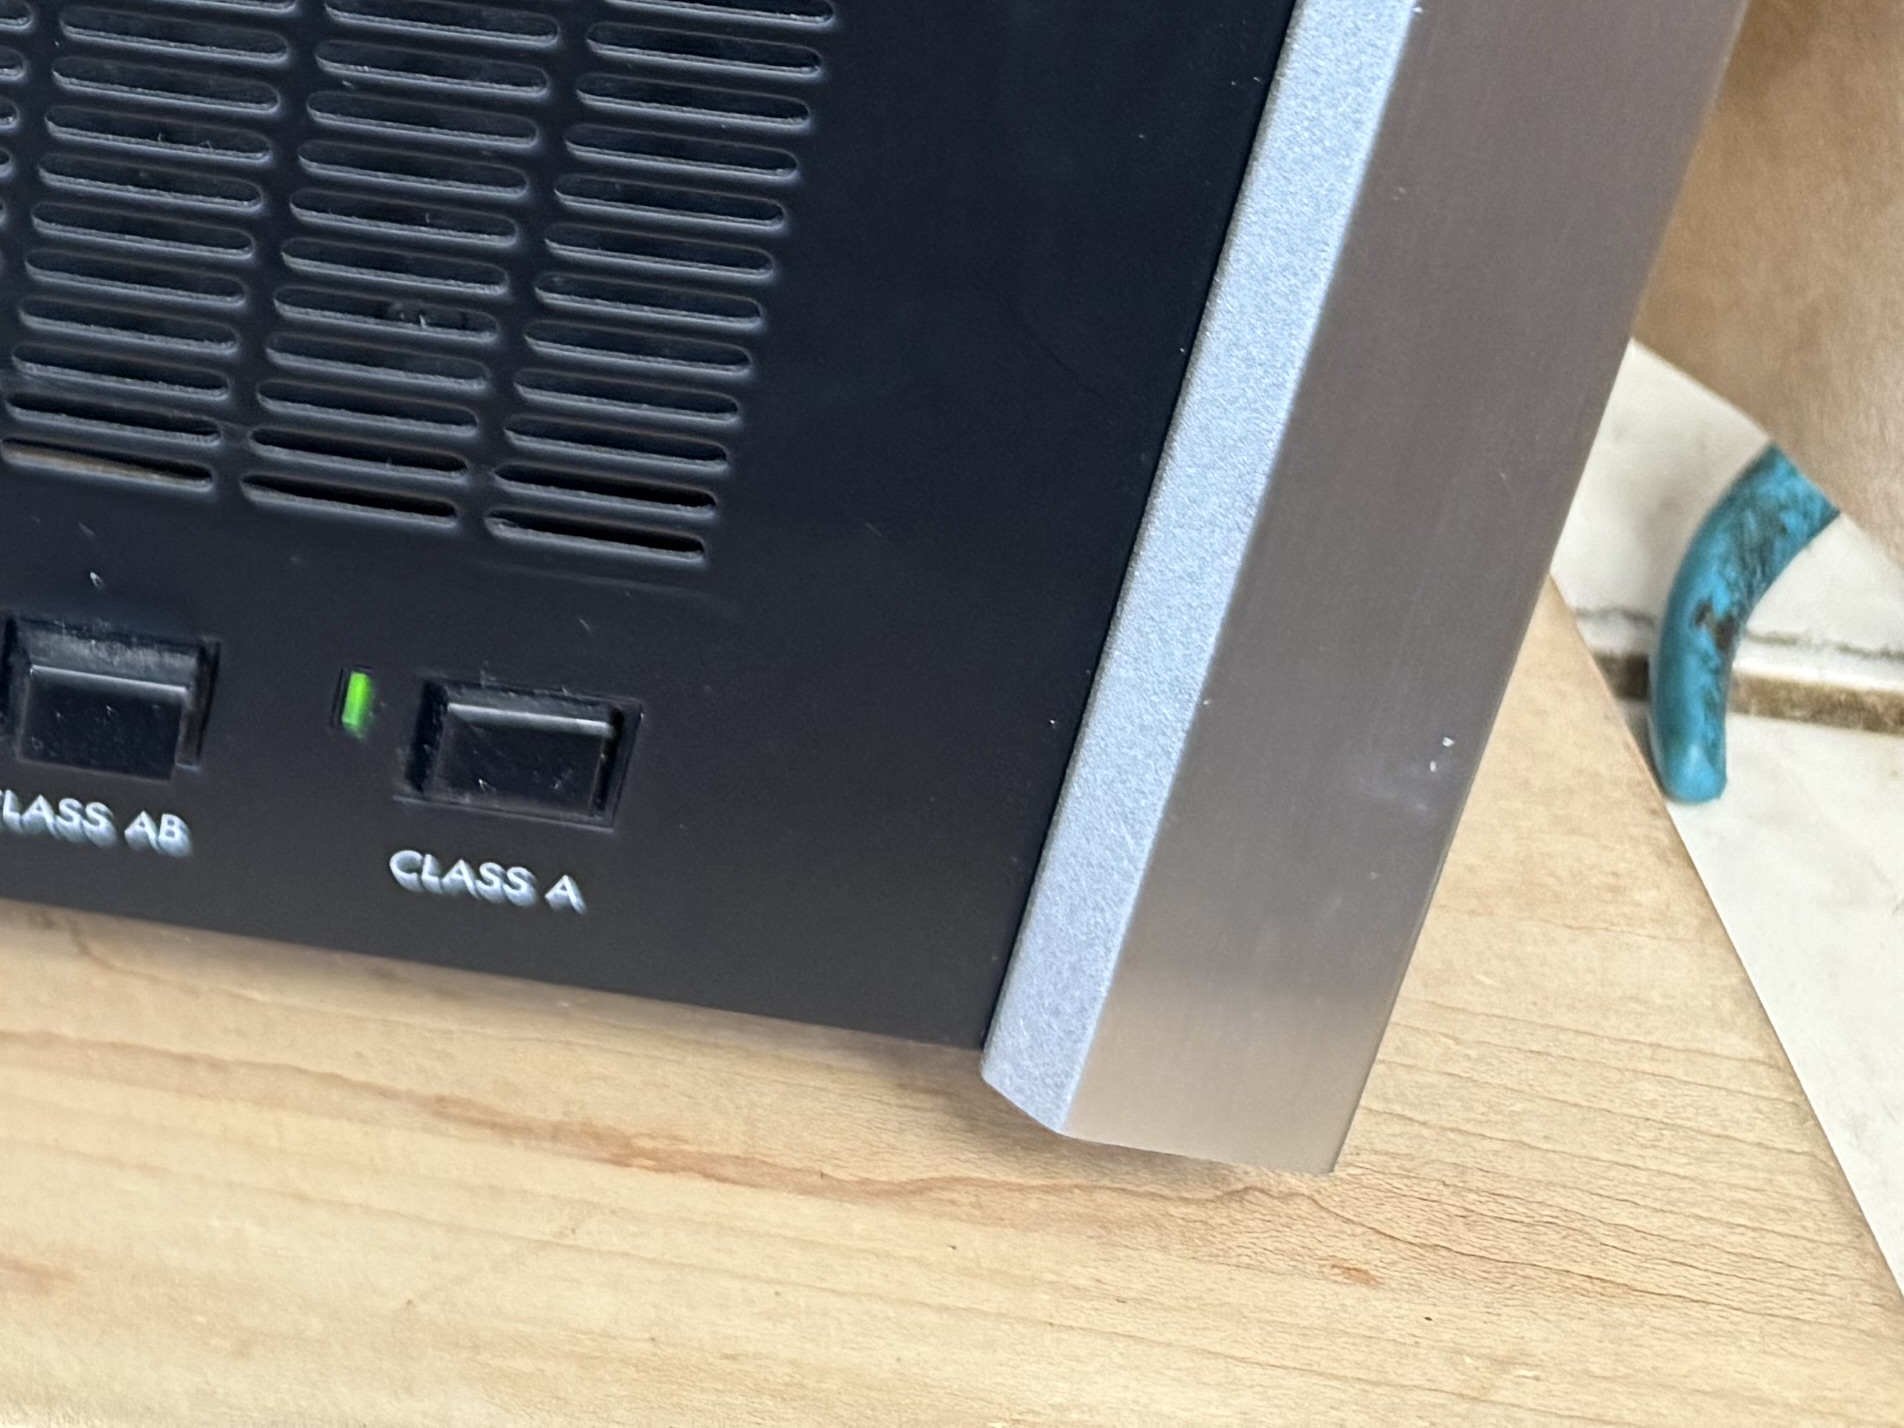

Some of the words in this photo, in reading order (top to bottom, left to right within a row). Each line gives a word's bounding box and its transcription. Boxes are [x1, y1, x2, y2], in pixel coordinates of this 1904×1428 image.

[123, 809, 192, 858] AB
[389, 849, 538, 907] CLASS
[544, 874, 586, 915] A
